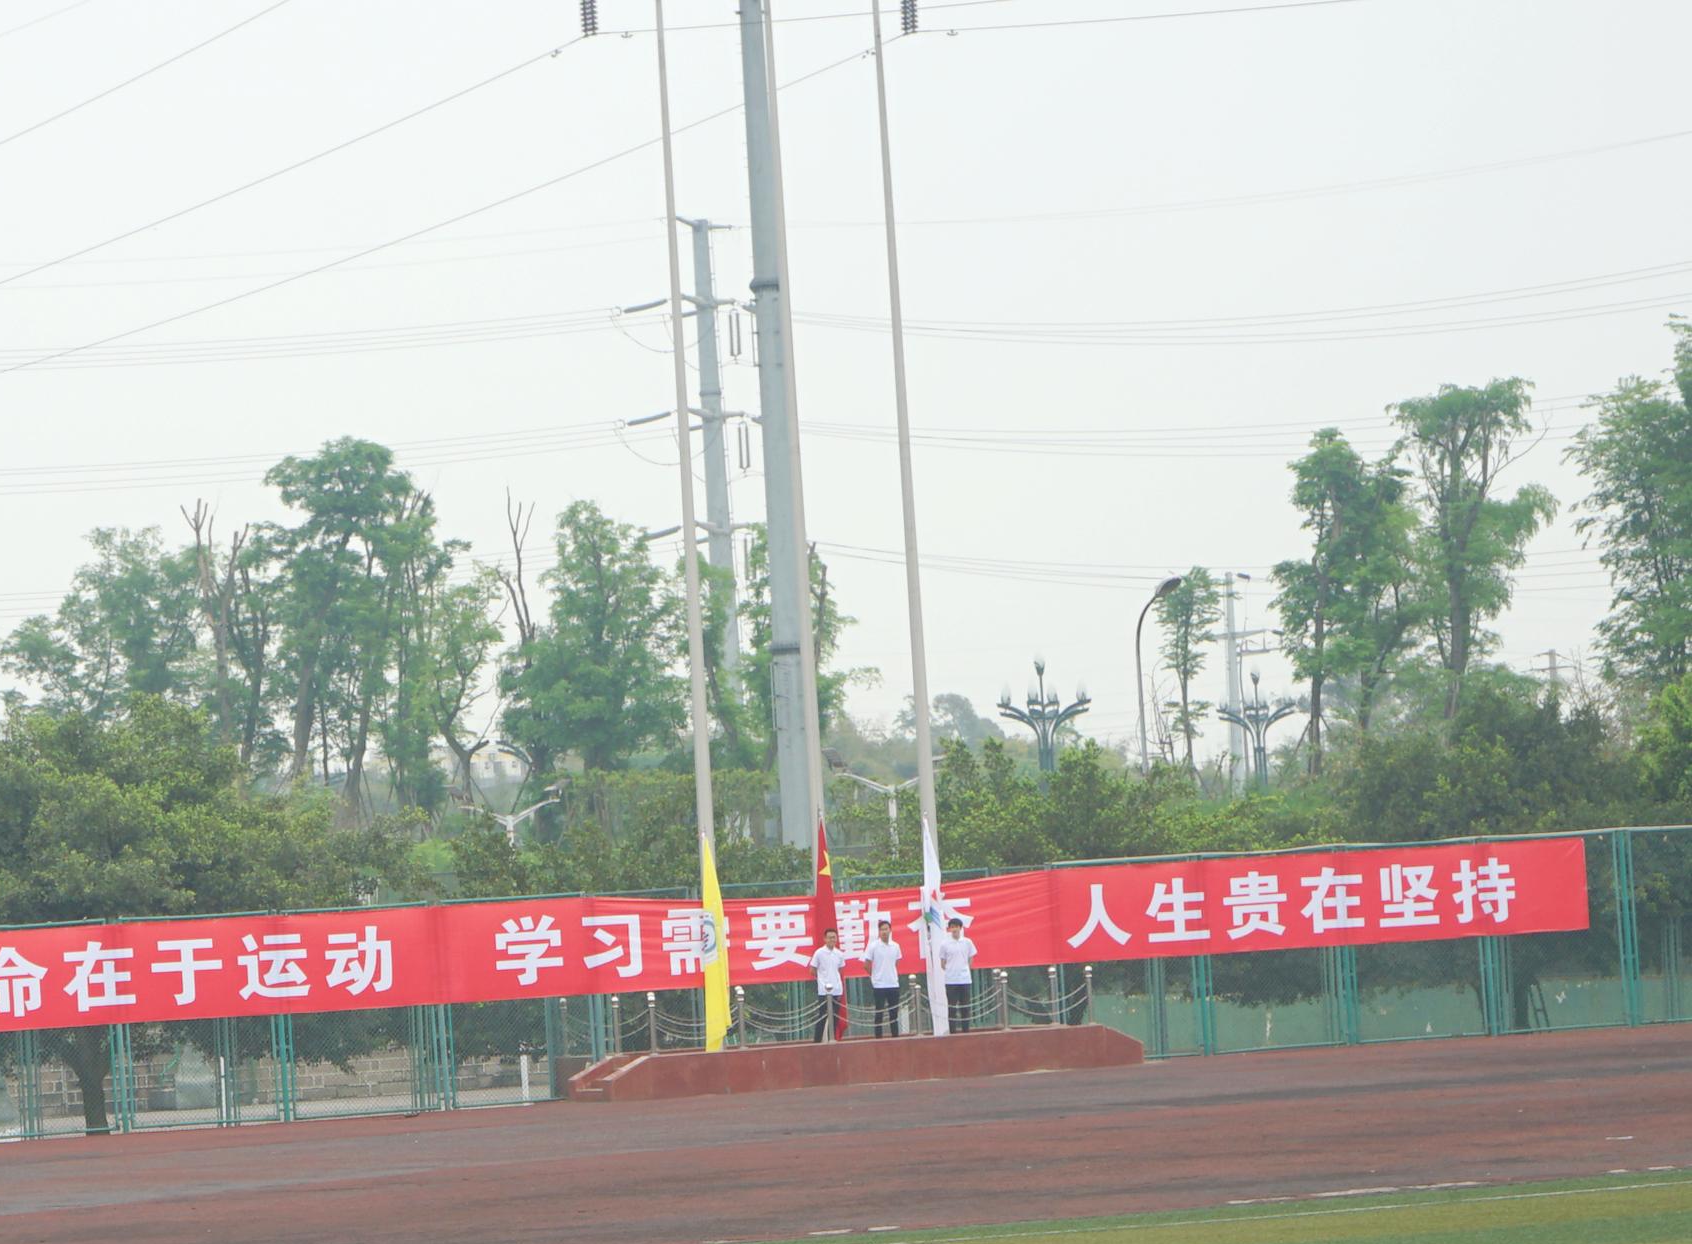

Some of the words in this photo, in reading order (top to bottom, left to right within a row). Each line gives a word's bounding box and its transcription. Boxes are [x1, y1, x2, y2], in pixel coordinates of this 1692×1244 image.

[1066, 857, 1516, 949] 人生贵在坚持
